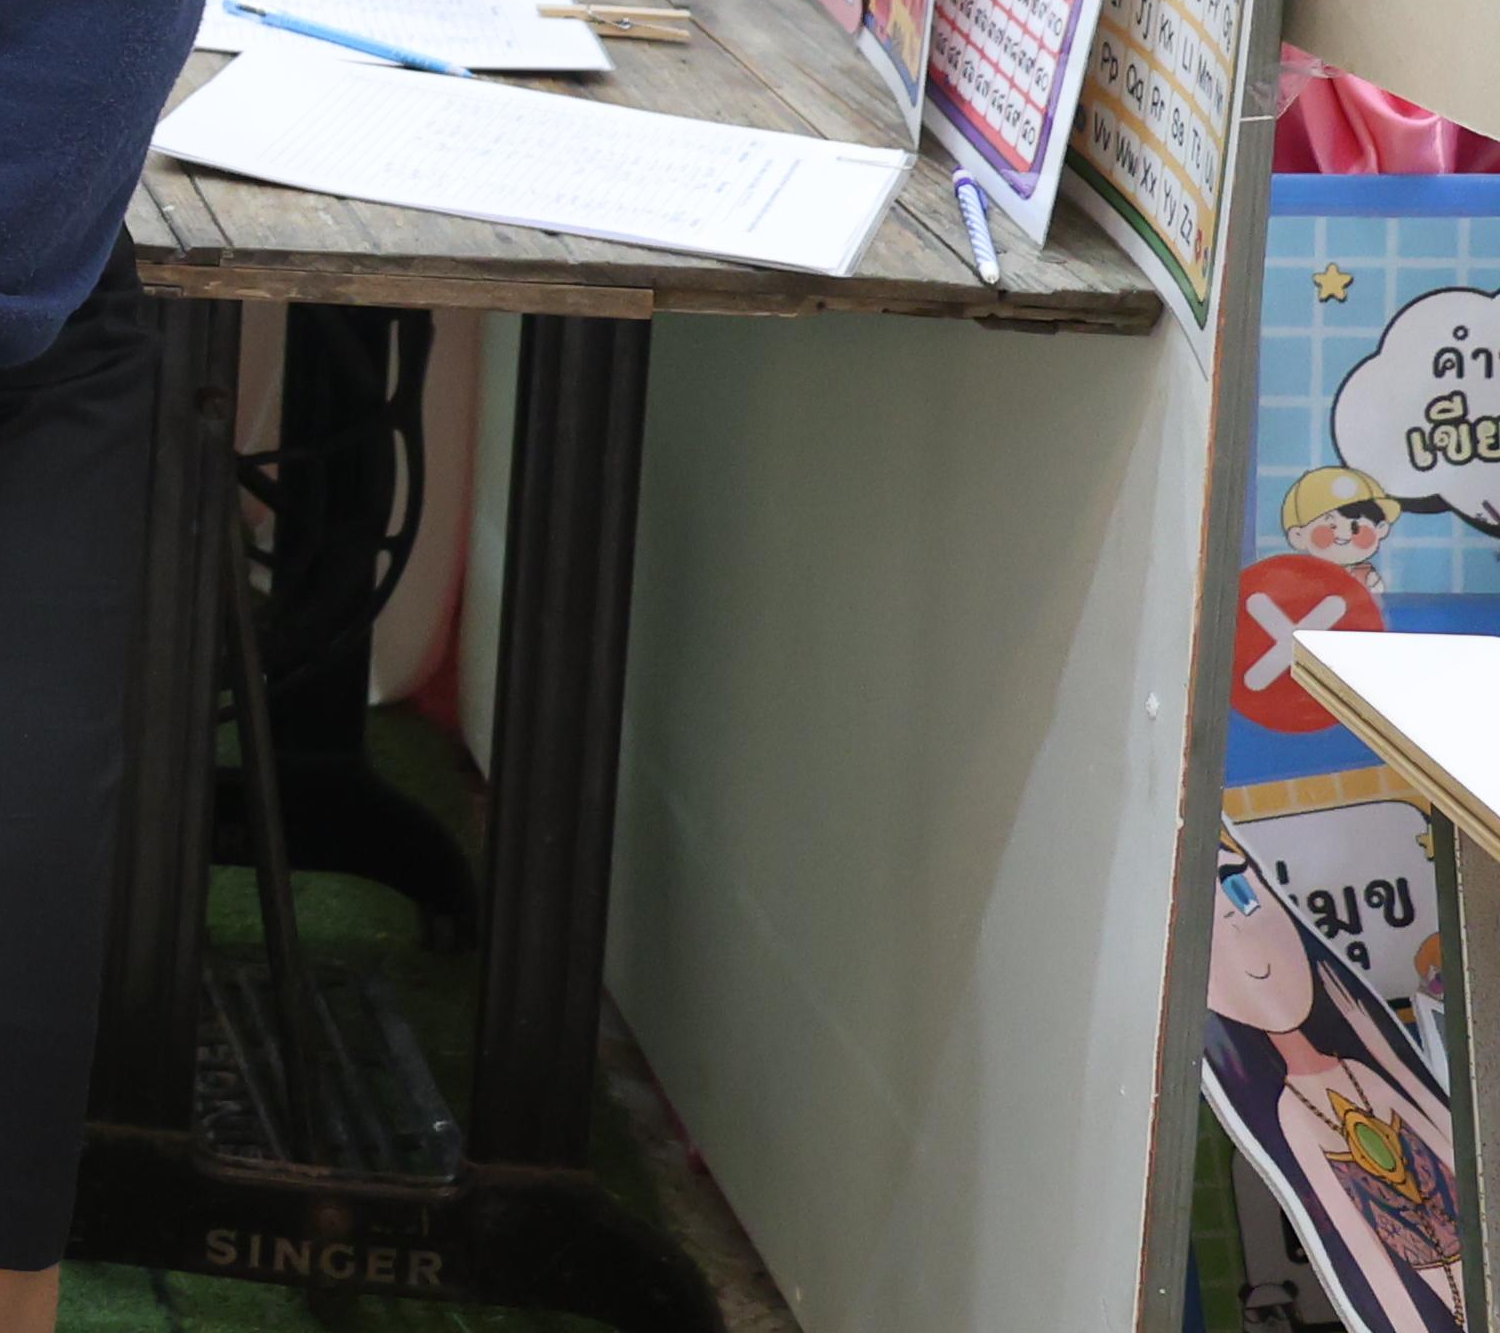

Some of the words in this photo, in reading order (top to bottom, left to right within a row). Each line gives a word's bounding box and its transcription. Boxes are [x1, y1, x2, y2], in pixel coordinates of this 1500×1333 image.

[1159, 13, 1175, 55] Kk
[1101, 41, 1119, 84] Pp
[1126, 63, 1145, 112] Qq
[1150, 86, 1166, 123] Rr
[1172, 107, 1185, 147] Ss
[1094, 110, 1111, 152] Vv
[1116, 130, 1139, 178] Ww
[1139, 156, 1157, 198] Xx
[1163, 179, 1178, 227] Yy
[1180, 204, 1194, 246] Zz
[1433, 325, 1500, 379] คำ
[205, 1227, 445, 1287] SINGER
